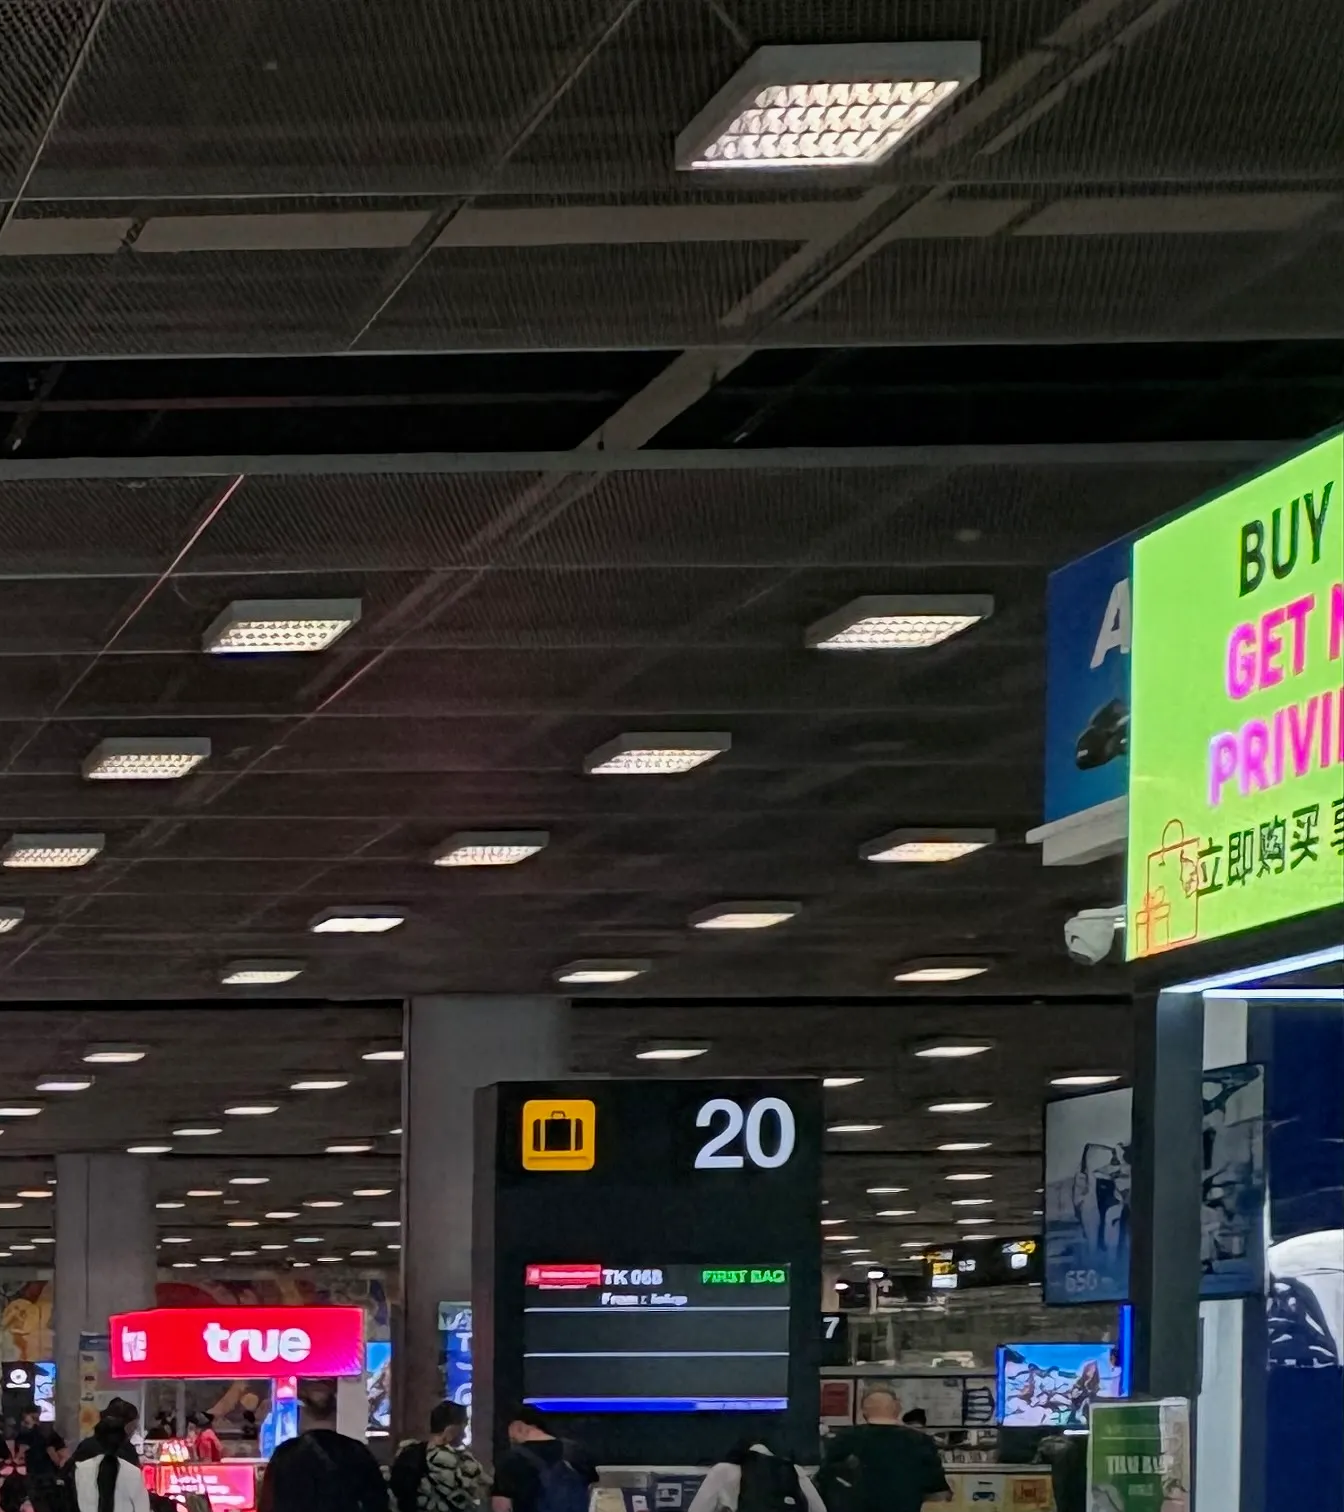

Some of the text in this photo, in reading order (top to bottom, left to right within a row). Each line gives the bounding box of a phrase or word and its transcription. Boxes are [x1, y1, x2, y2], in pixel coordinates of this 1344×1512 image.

[1239, 481, 1334, 598] BUY
[1224, 593, 1316, 702] GET
[1196, 803, 1320, 898] 立即购买
[693, 1097, 796, 1169] 20
[602, 1269, 629, 1285] TK
[702, 1270, 748, 1284] FIRST
[750, 1269, 785, 1284] BAG
[203, 1322, 312, 1363] true
